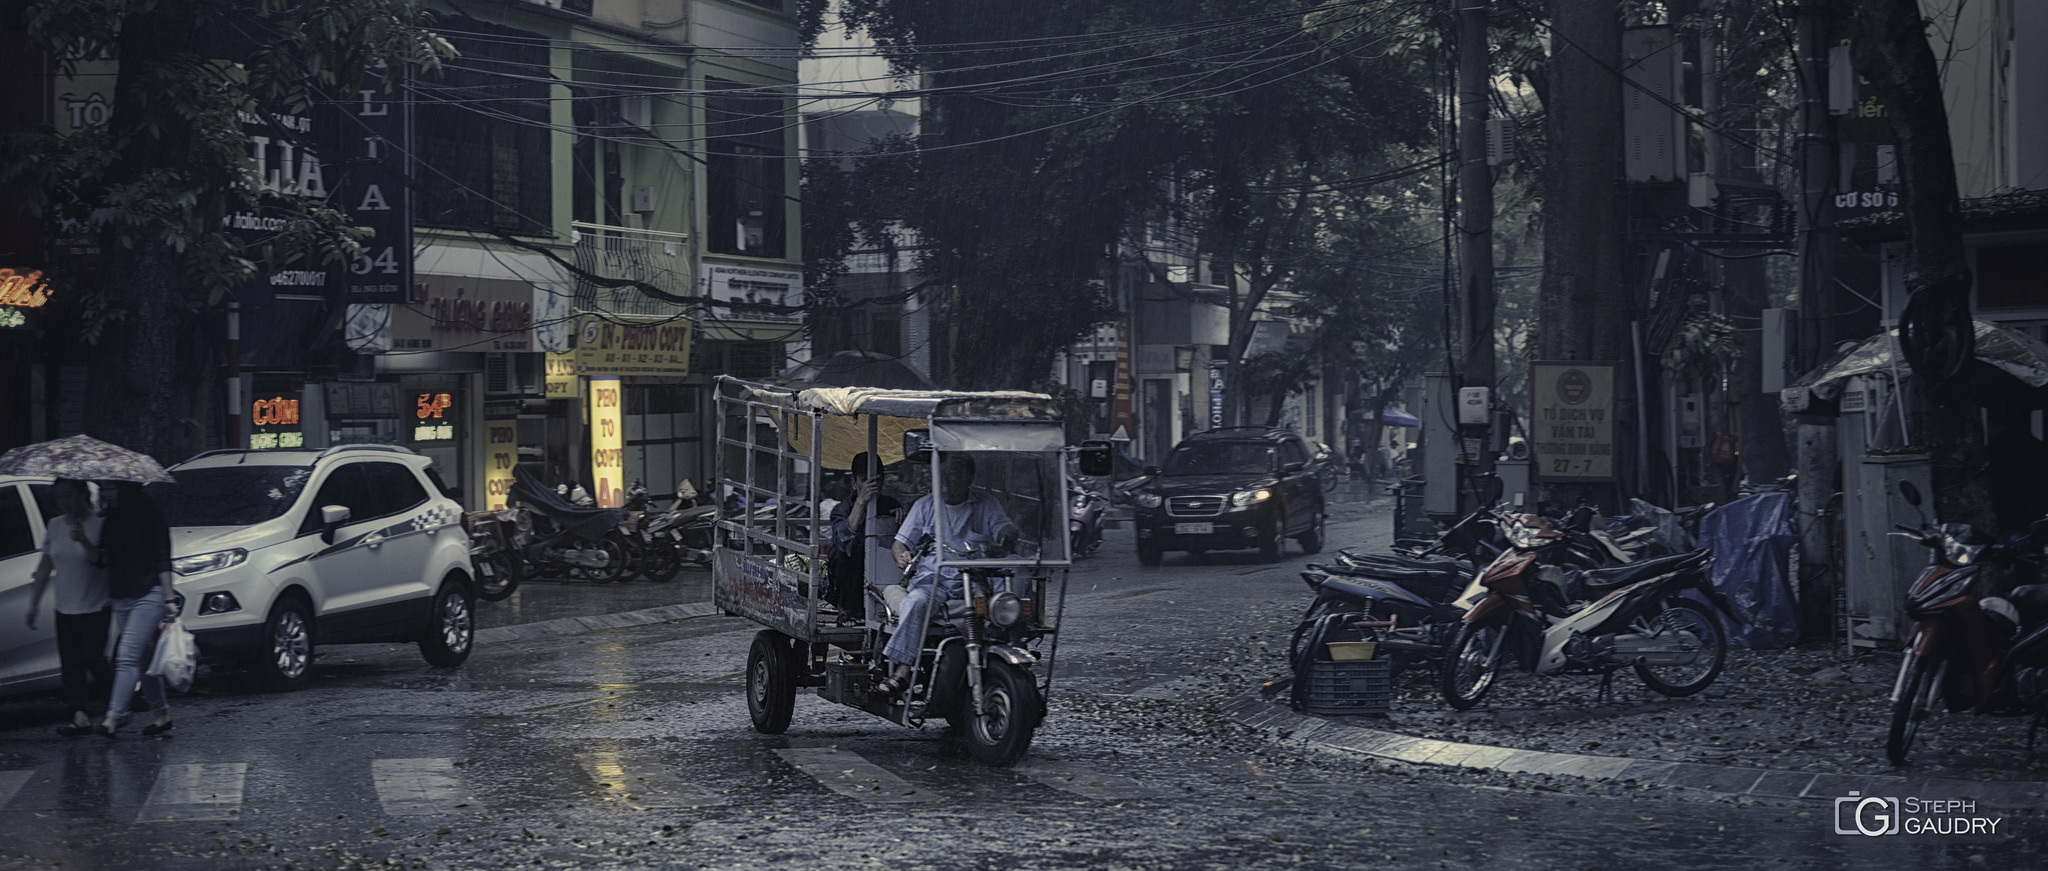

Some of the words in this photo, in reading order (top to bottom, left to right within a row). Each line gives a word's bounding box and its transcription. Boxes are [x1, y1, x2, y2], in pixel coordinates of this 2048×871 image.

[1835, 191, 1859, 208] CƠ
[1887, 191, 1899, 207] 6
[351, 246, 399, 275] 54
[621, 325, 658, 351] PHOTO
[659, 326, 688, 352] COPY
[596, 388, 618, 408] PHO
[253, 396, 299, 426] CƠM
[1559, 408, 1587, 424] DỊCH
[489, 427, 513, 444] PHO
[600, 418, 615, 437] TO
[494, 453, 511, 470] TO
[1553, 459, 1571, 473] 27
[1583, 459, 1593, 474] 7
[488, 478, 517, 497] COP
